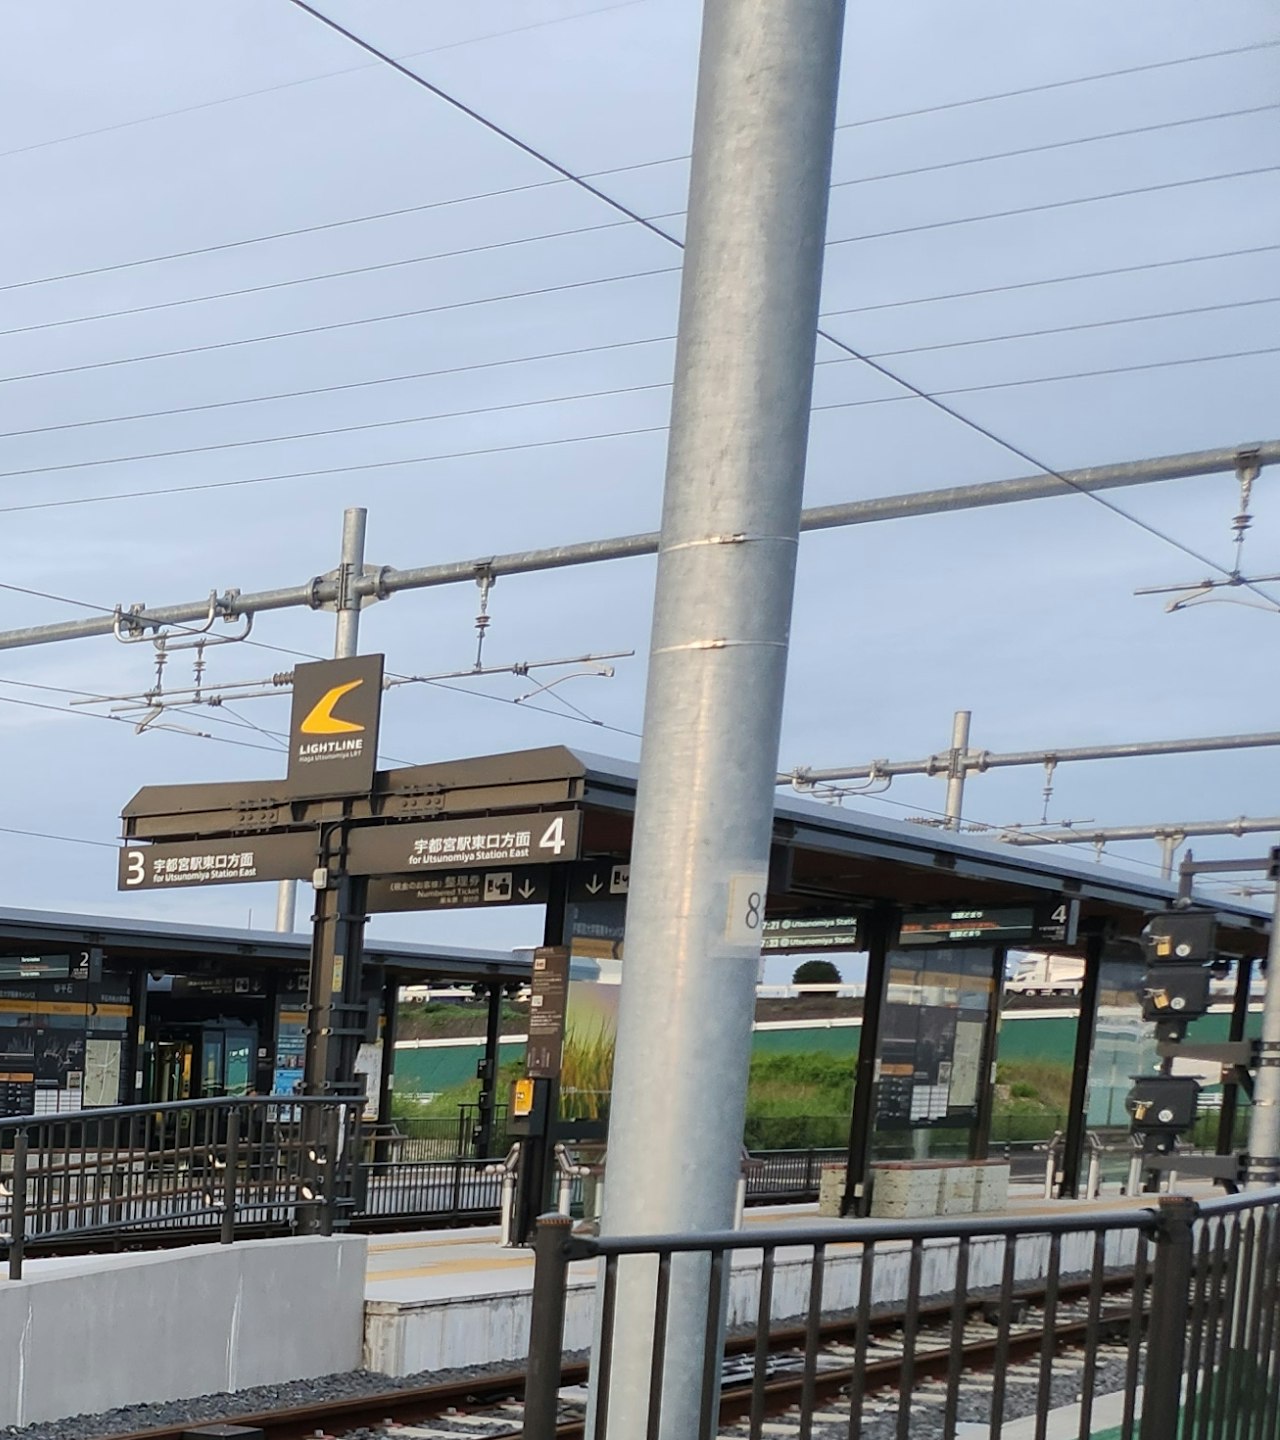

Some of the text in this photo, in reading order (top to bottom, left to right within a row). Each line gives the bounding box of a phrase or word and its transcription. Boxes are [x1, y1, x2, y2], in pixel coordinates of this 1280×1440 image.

[299, 739, 363, 755] LIGHTLINE
[414, 832, 531, 854] 宇都宮駅東口方面
[539, 817, 566, 855] 4
[153, 852, 254, 873] 宇都宮駅東口方面
[409, 848, 529, 864] for Utsunomiya Station East
[126, 851, 145, 885] 3
[153, 867, 256, 883] for Utsunomiya Station East
[417, 889, 456, 898] Numbered
[1051, 905, 1066, 923] 4
[792, 920, 835, 928] Utsunomiya
[790, 938, 833, 947] Utsunomiya
[80, 952, 89, 967] 2
